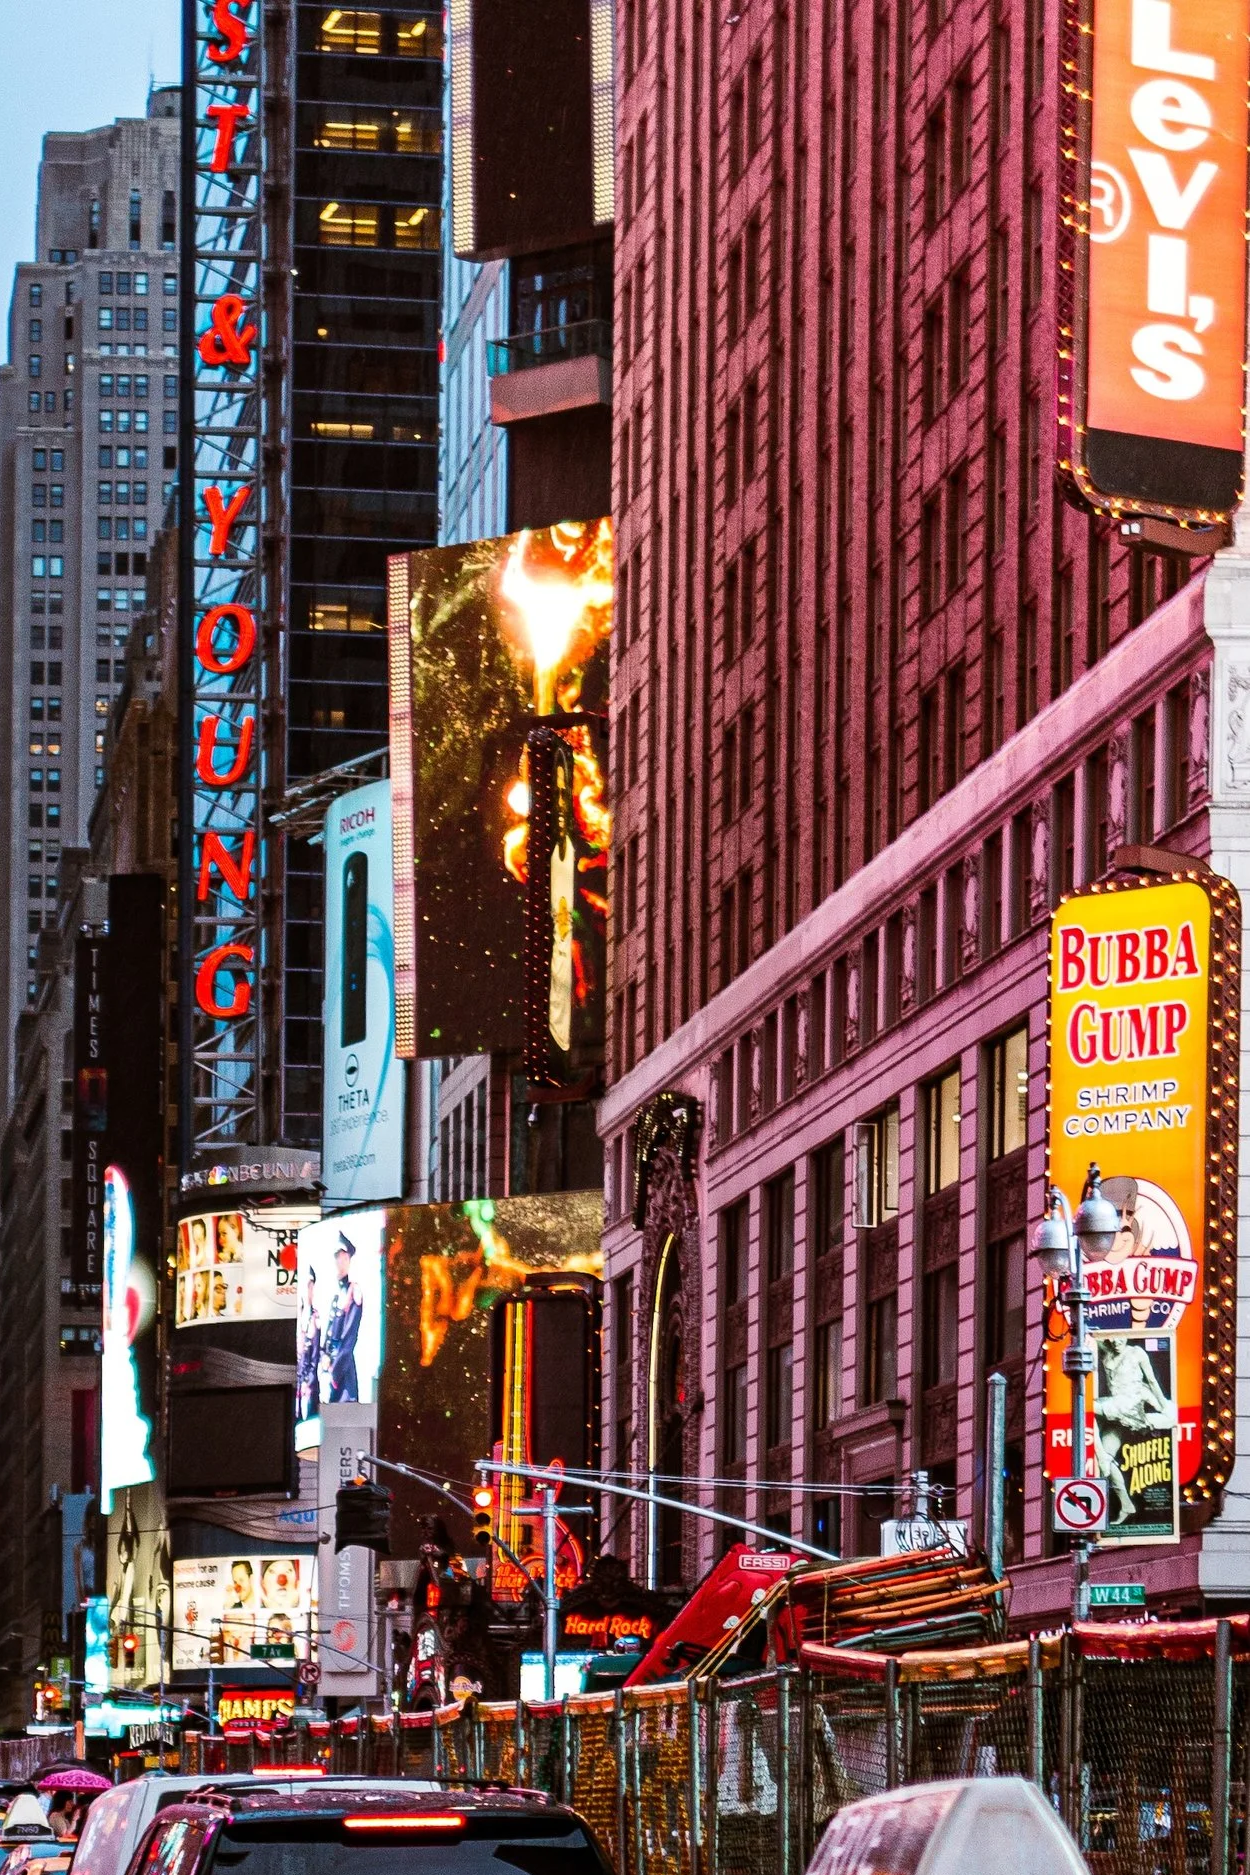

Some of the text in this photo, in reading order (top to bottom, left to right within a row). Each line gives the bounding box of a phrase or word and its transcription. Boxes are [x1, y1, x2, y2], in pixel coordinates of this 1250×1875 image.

[195, 486, 256, 1020] YOUNG
[339, 806, 376, 835] RICOH
[1058, 923, 1199, 992] BUBBA
[89, 949, 100, 1058] TIMES
[1069, 1002, 1187, 1066] GUMP
[338, 1088, 370, 1113] THETA
[1078, 1081, 1177, 1108] SHRIMP
[1065, 1107, 1190, 1136] COMPANY
[87, 1141, 97, 1274] SQUARE
[1060, 1261, 1193, 1297] BBA GUMP
[1121, 1436, 1171, 1472] SHUFFLE
[1129, 1460, 1172, 1497] ALONG
[742, 1556, 786, 1569] FASSI
[1095, 1589, 1109, 1602] W
[1111, 1588, 1131, 1602] 44
[565, 1615, 652, 1638] Hard Rock
